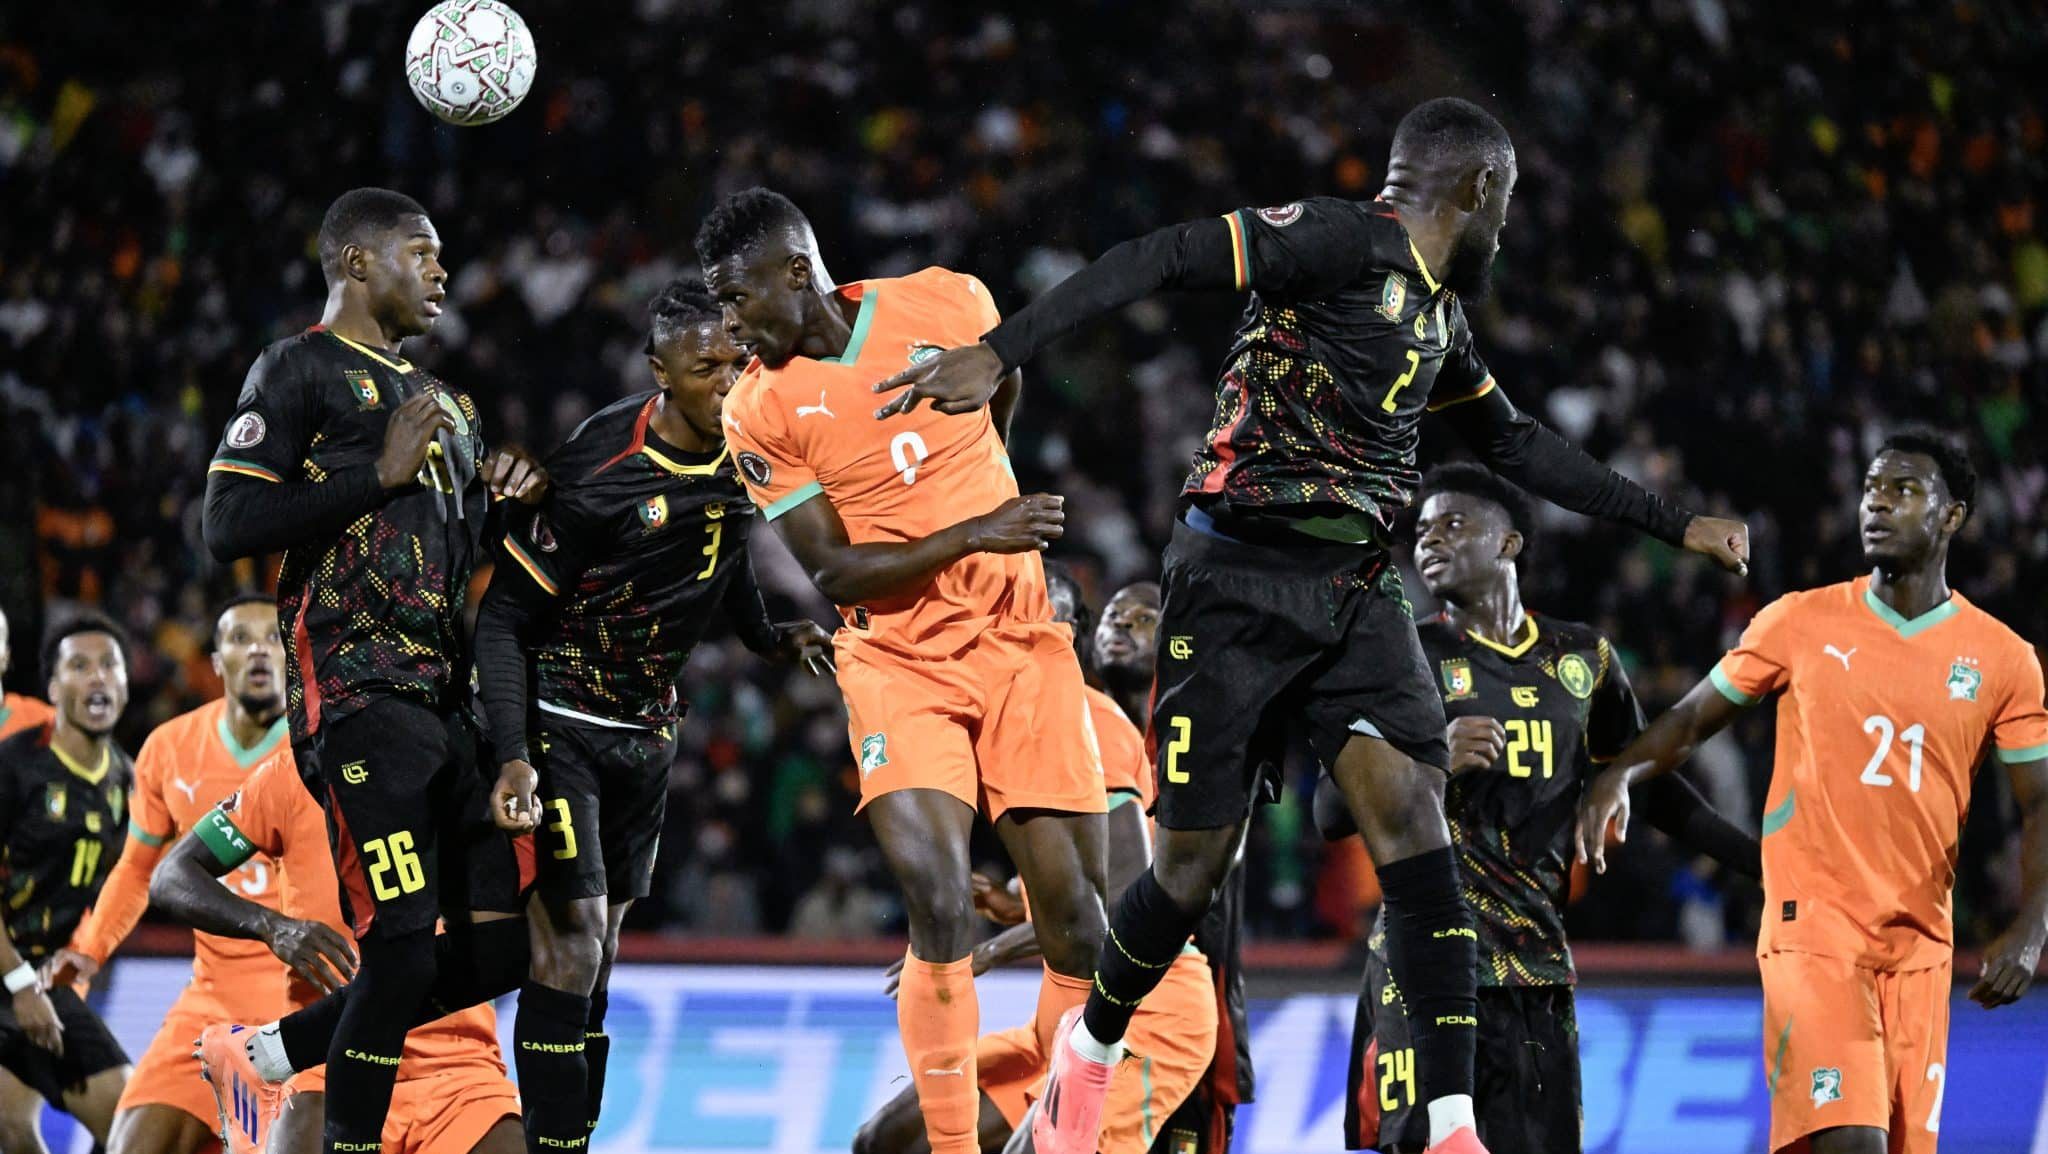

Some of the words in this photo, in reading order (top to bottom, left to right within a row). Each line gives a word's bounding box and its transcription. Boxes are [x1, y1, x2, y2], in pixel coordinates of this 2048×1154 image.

[1381, 350, 1420, 414] 2
[696, 522, 722, 581] 3
[1167, 716, 1192, 784] 2
[1504, 720, 1553, 779] 24
[1860, 715, 1925, 793] 21
[212, 814, 247, 850] CAF
[544, 798, 578, 860] 3
[362, 830, 427, 902] 26
[1378, 1048, 1416, 1112] 24
